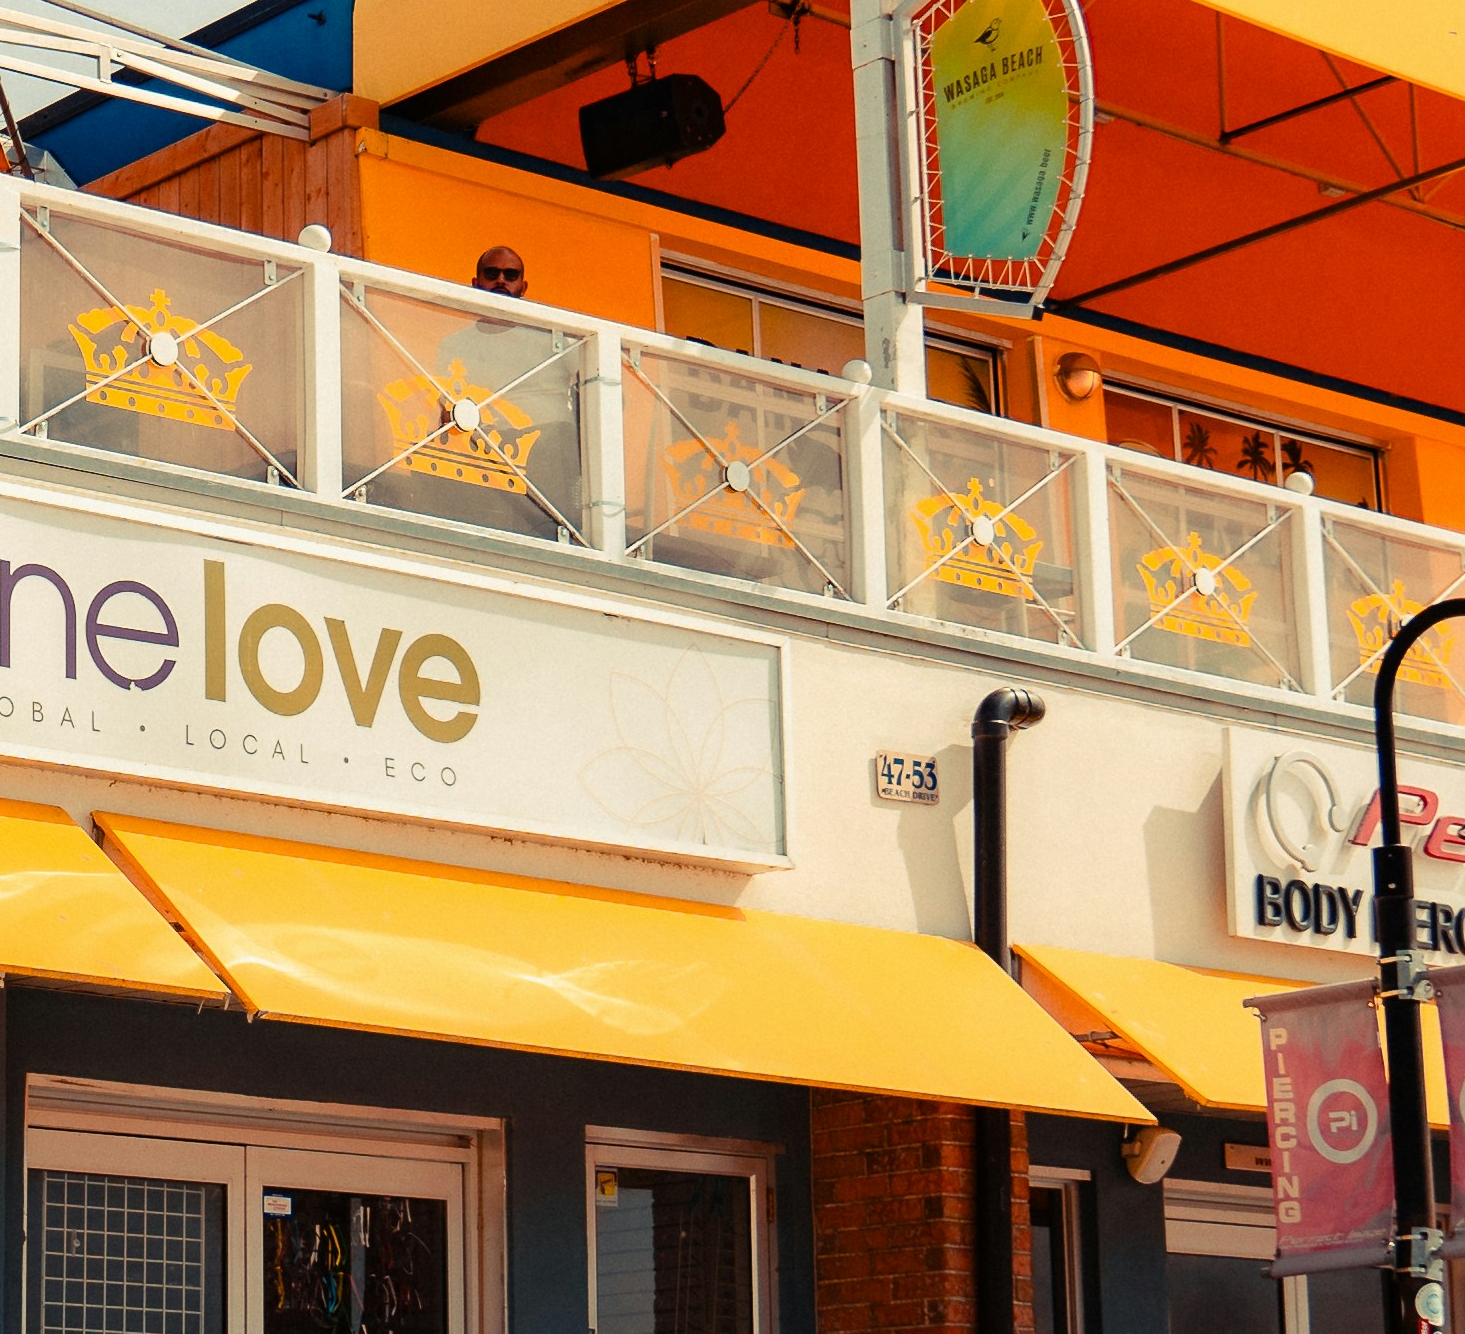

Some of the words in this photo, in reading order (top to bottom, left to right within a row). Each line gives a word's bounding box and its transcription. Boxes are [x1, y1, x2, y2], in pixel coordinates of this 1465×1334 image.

[943, 62, 997, 103] WASAGA
[1002, 46, 1043, 76] BEACH
[203, 558, 481, 745] love
[185, 724, 314, 768] LOCAL
[385, 757, 460, 788] ECO
[1256, 873, 1364, 939] BODY
[1269, 1027, 1302, 1224] PIERCING
